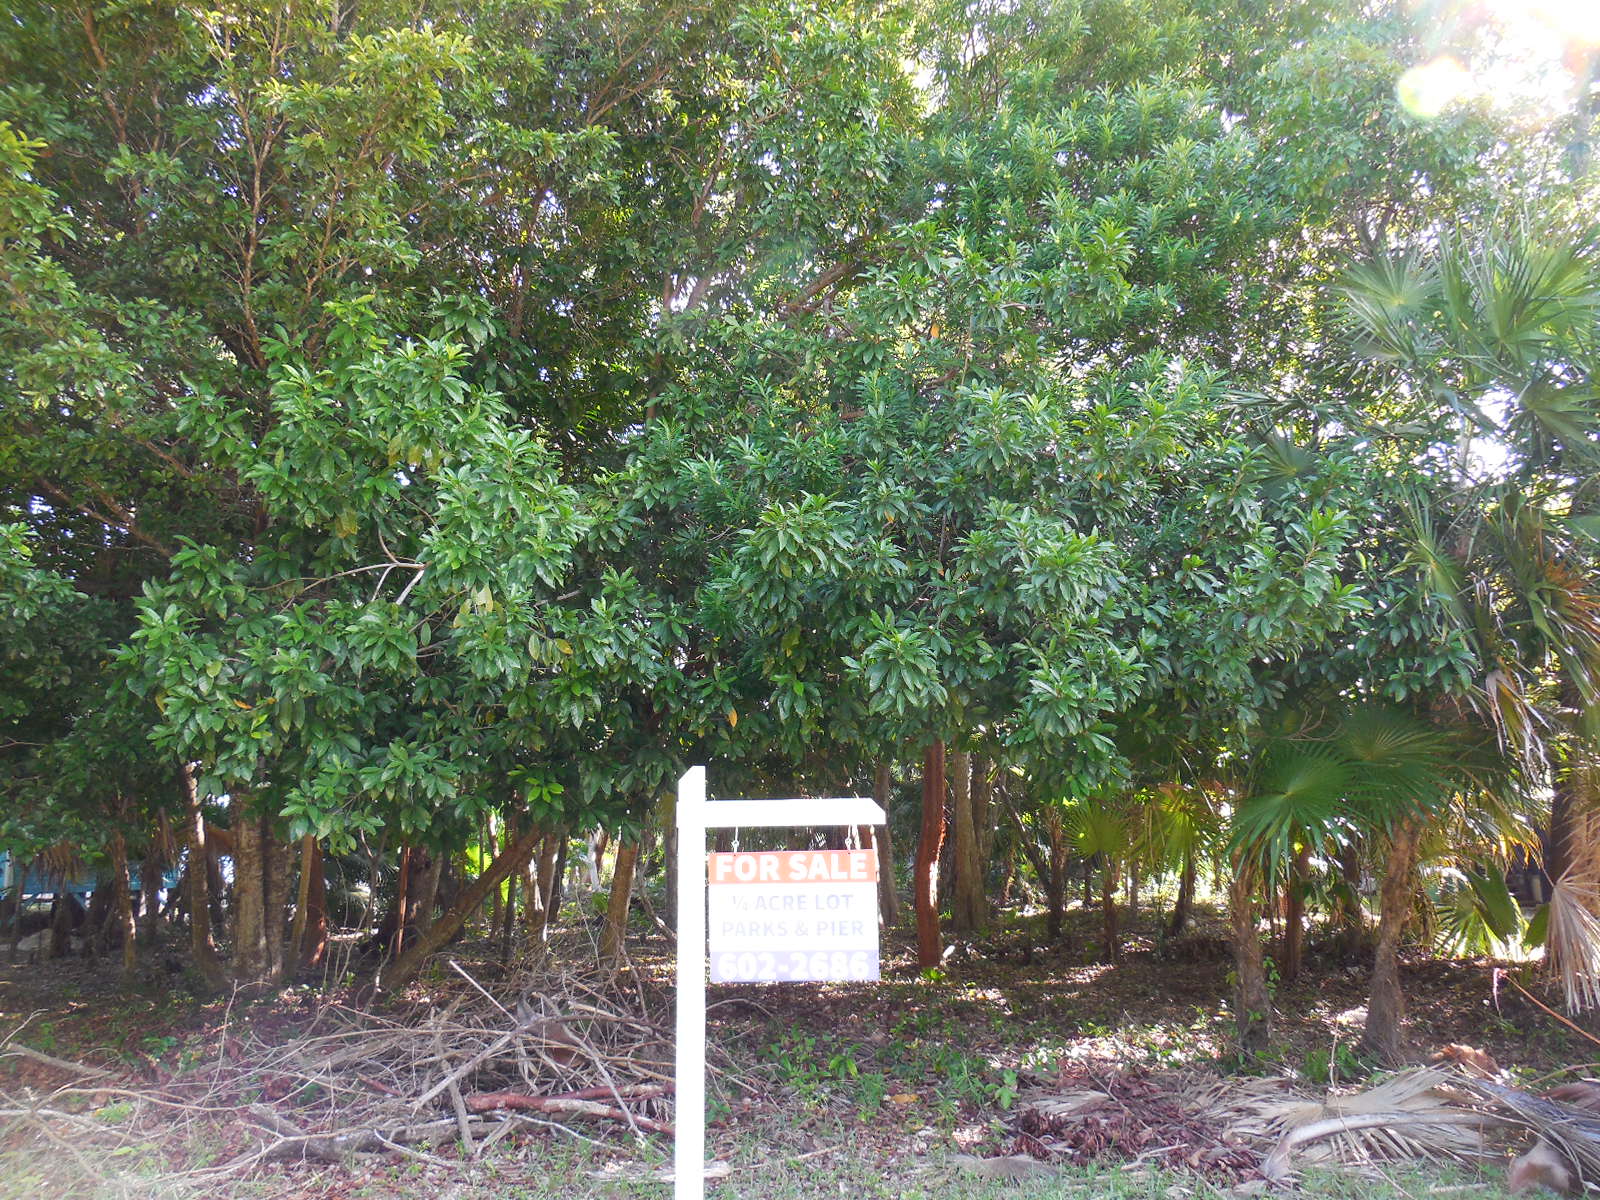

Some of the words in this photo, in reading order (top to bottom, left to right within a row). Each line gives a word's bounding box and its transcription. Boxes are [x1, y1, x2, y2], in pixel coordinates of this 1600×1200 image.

[716, 855, 780, 881] FOR
[789, 853, 868, 880] SALE
[755, 895, 808, 911] ACRE
[815, 894, 854, 910] LOT
[722, 921, 789, 936] PARKS
[794, 921, 809, 936] &
[816, 920, 864, 936] PIER
[718, 952, 869, 980] 602-2686
